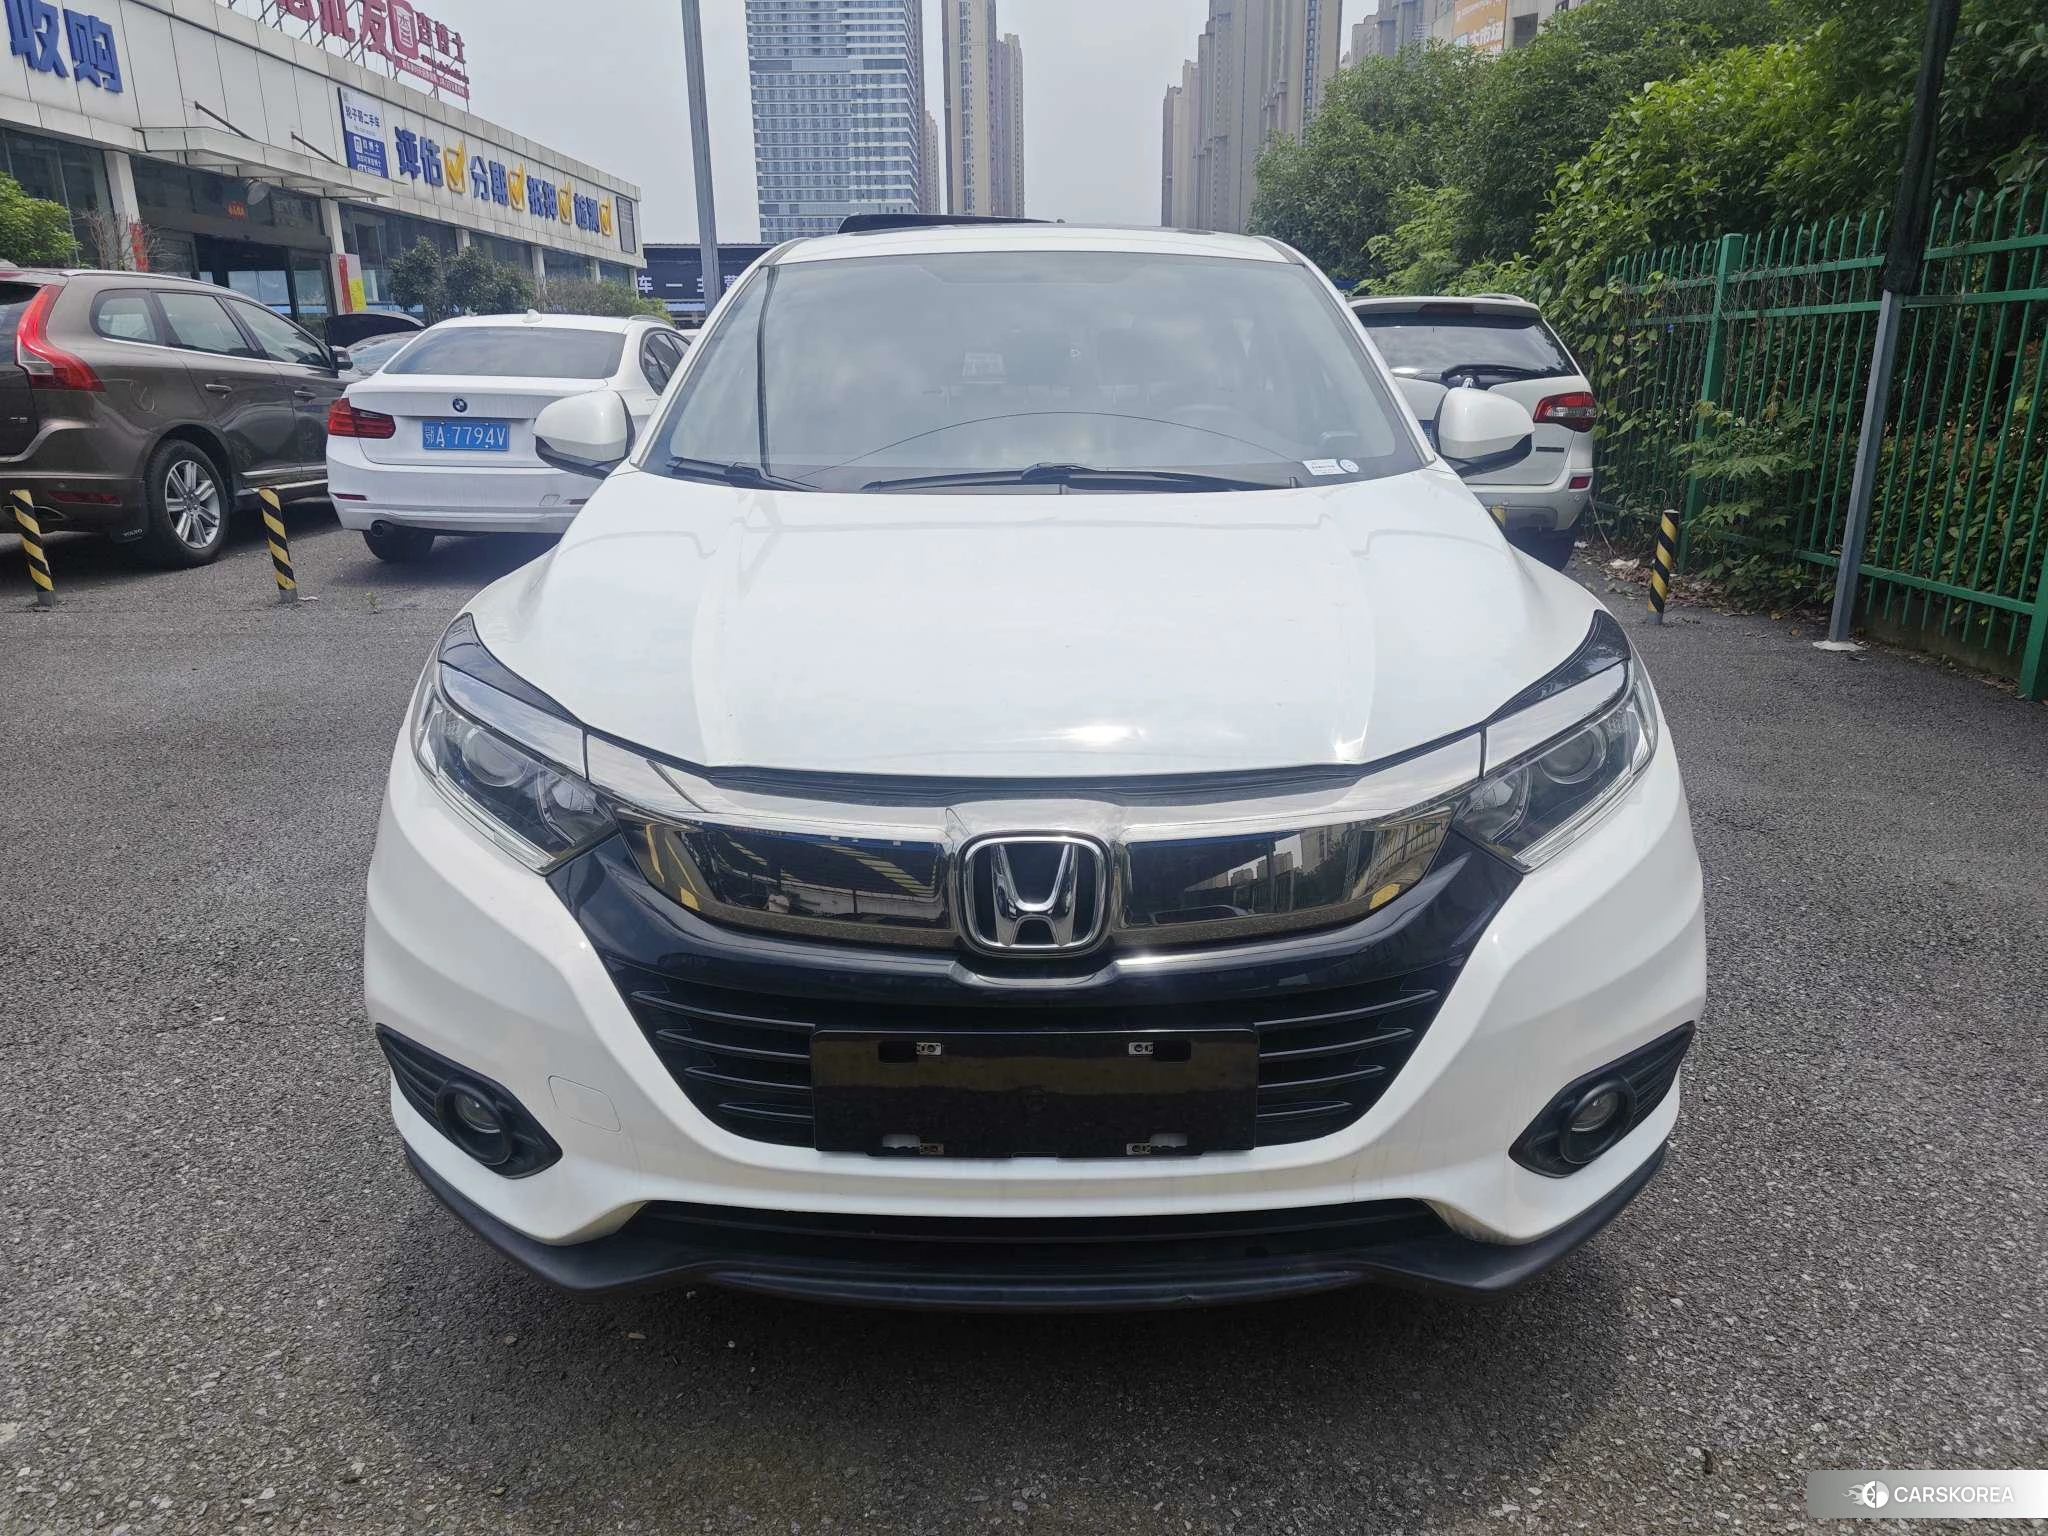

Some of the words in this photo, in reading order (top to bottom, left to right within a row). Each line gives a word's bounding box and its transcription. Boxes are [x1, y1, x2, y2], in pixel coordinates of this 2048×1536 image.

[4, 0, 124, 93] 收购
[277, 0, 395, 63] 批发
[395, 126, 444, 187] 评估
[470, 155, 509, 207] 分期
